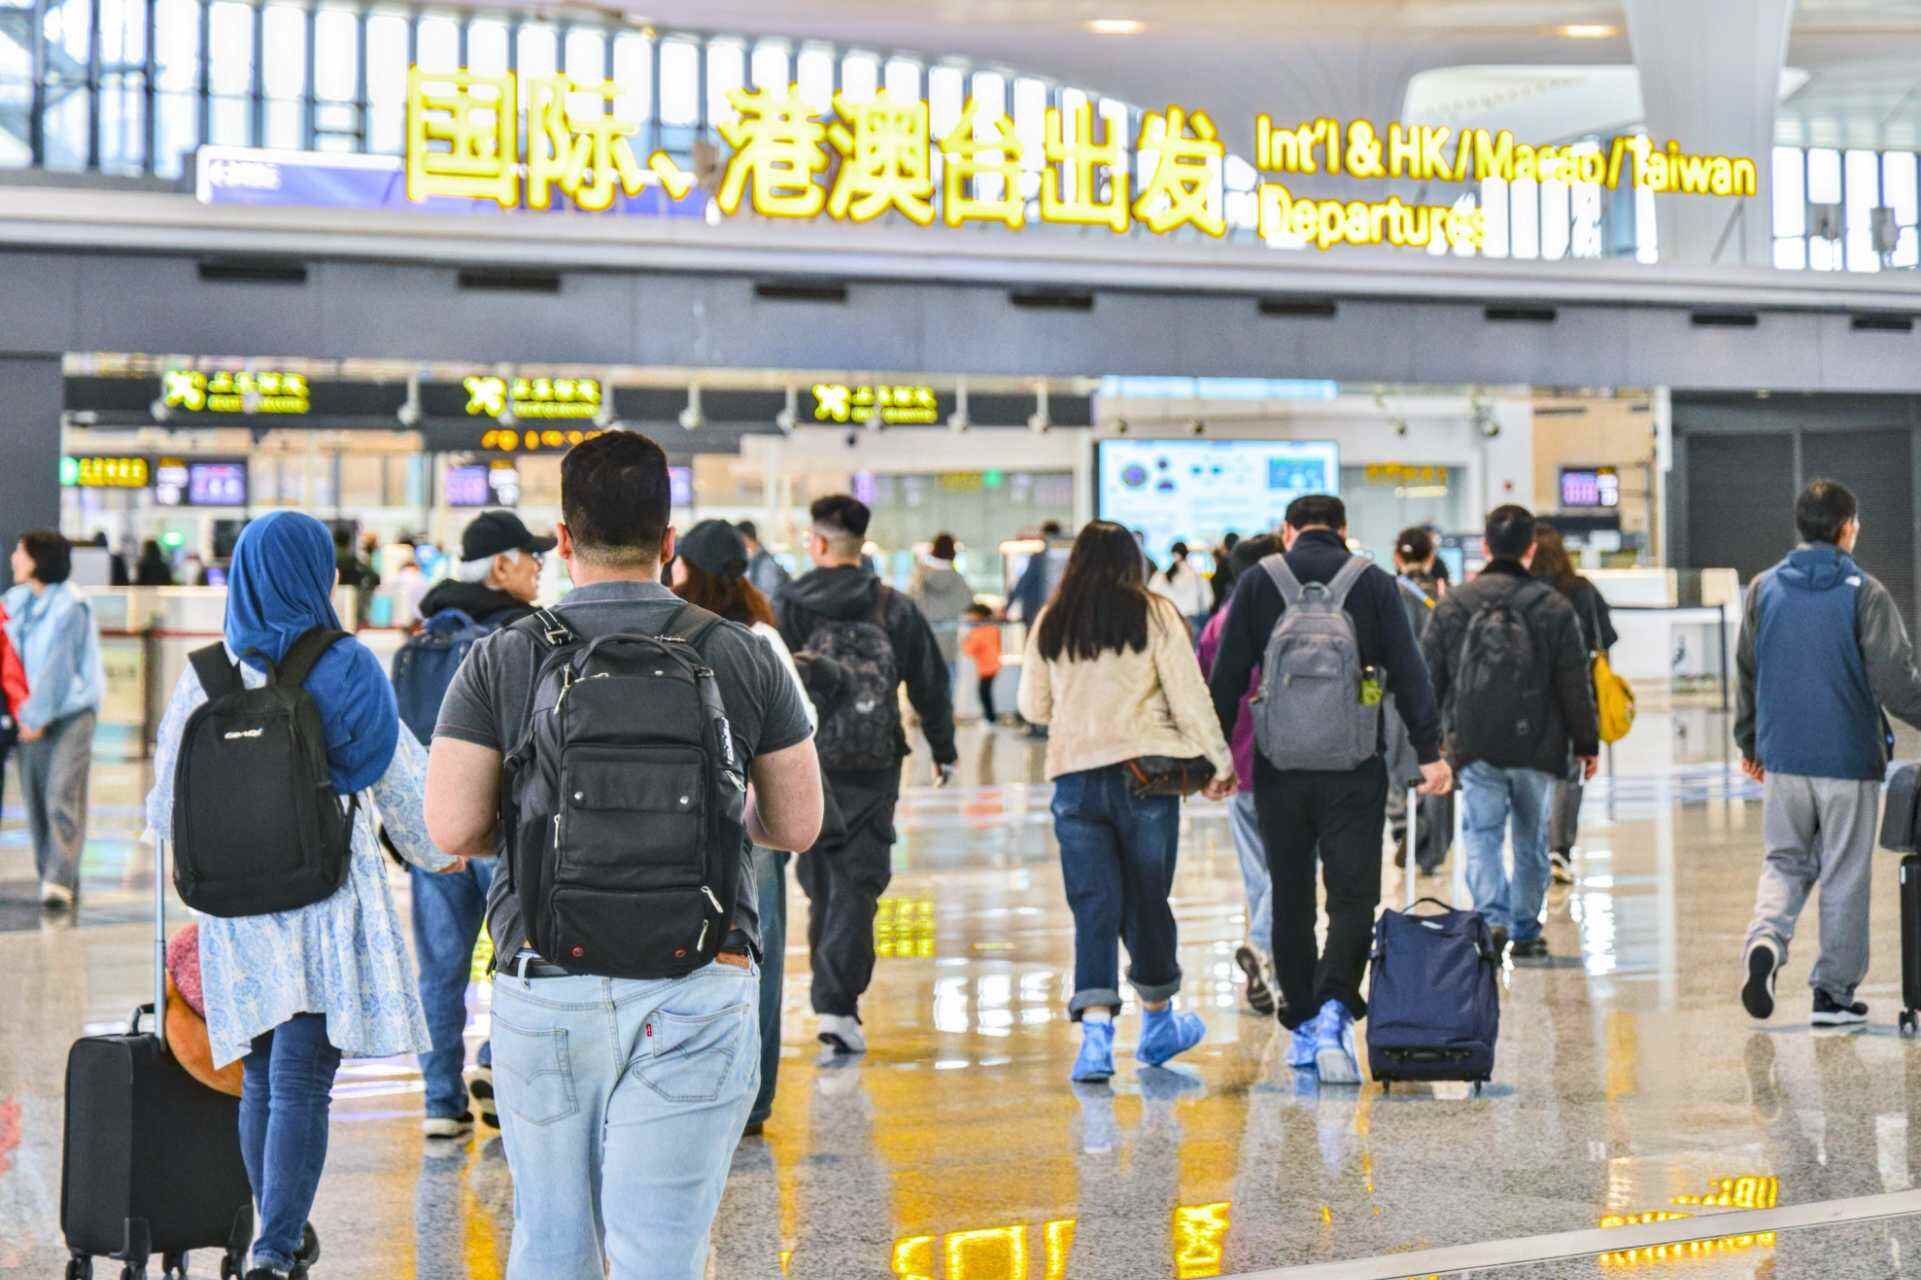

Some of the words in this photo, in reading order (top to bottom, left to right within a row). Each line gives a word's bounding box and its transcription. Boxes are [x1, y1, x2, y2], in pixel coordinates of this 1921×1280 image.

[1256, 112, 1341, 174] Int'l
[1345, 119, 1386, 179] &
[1257, 182, 1486, 252] Departures
